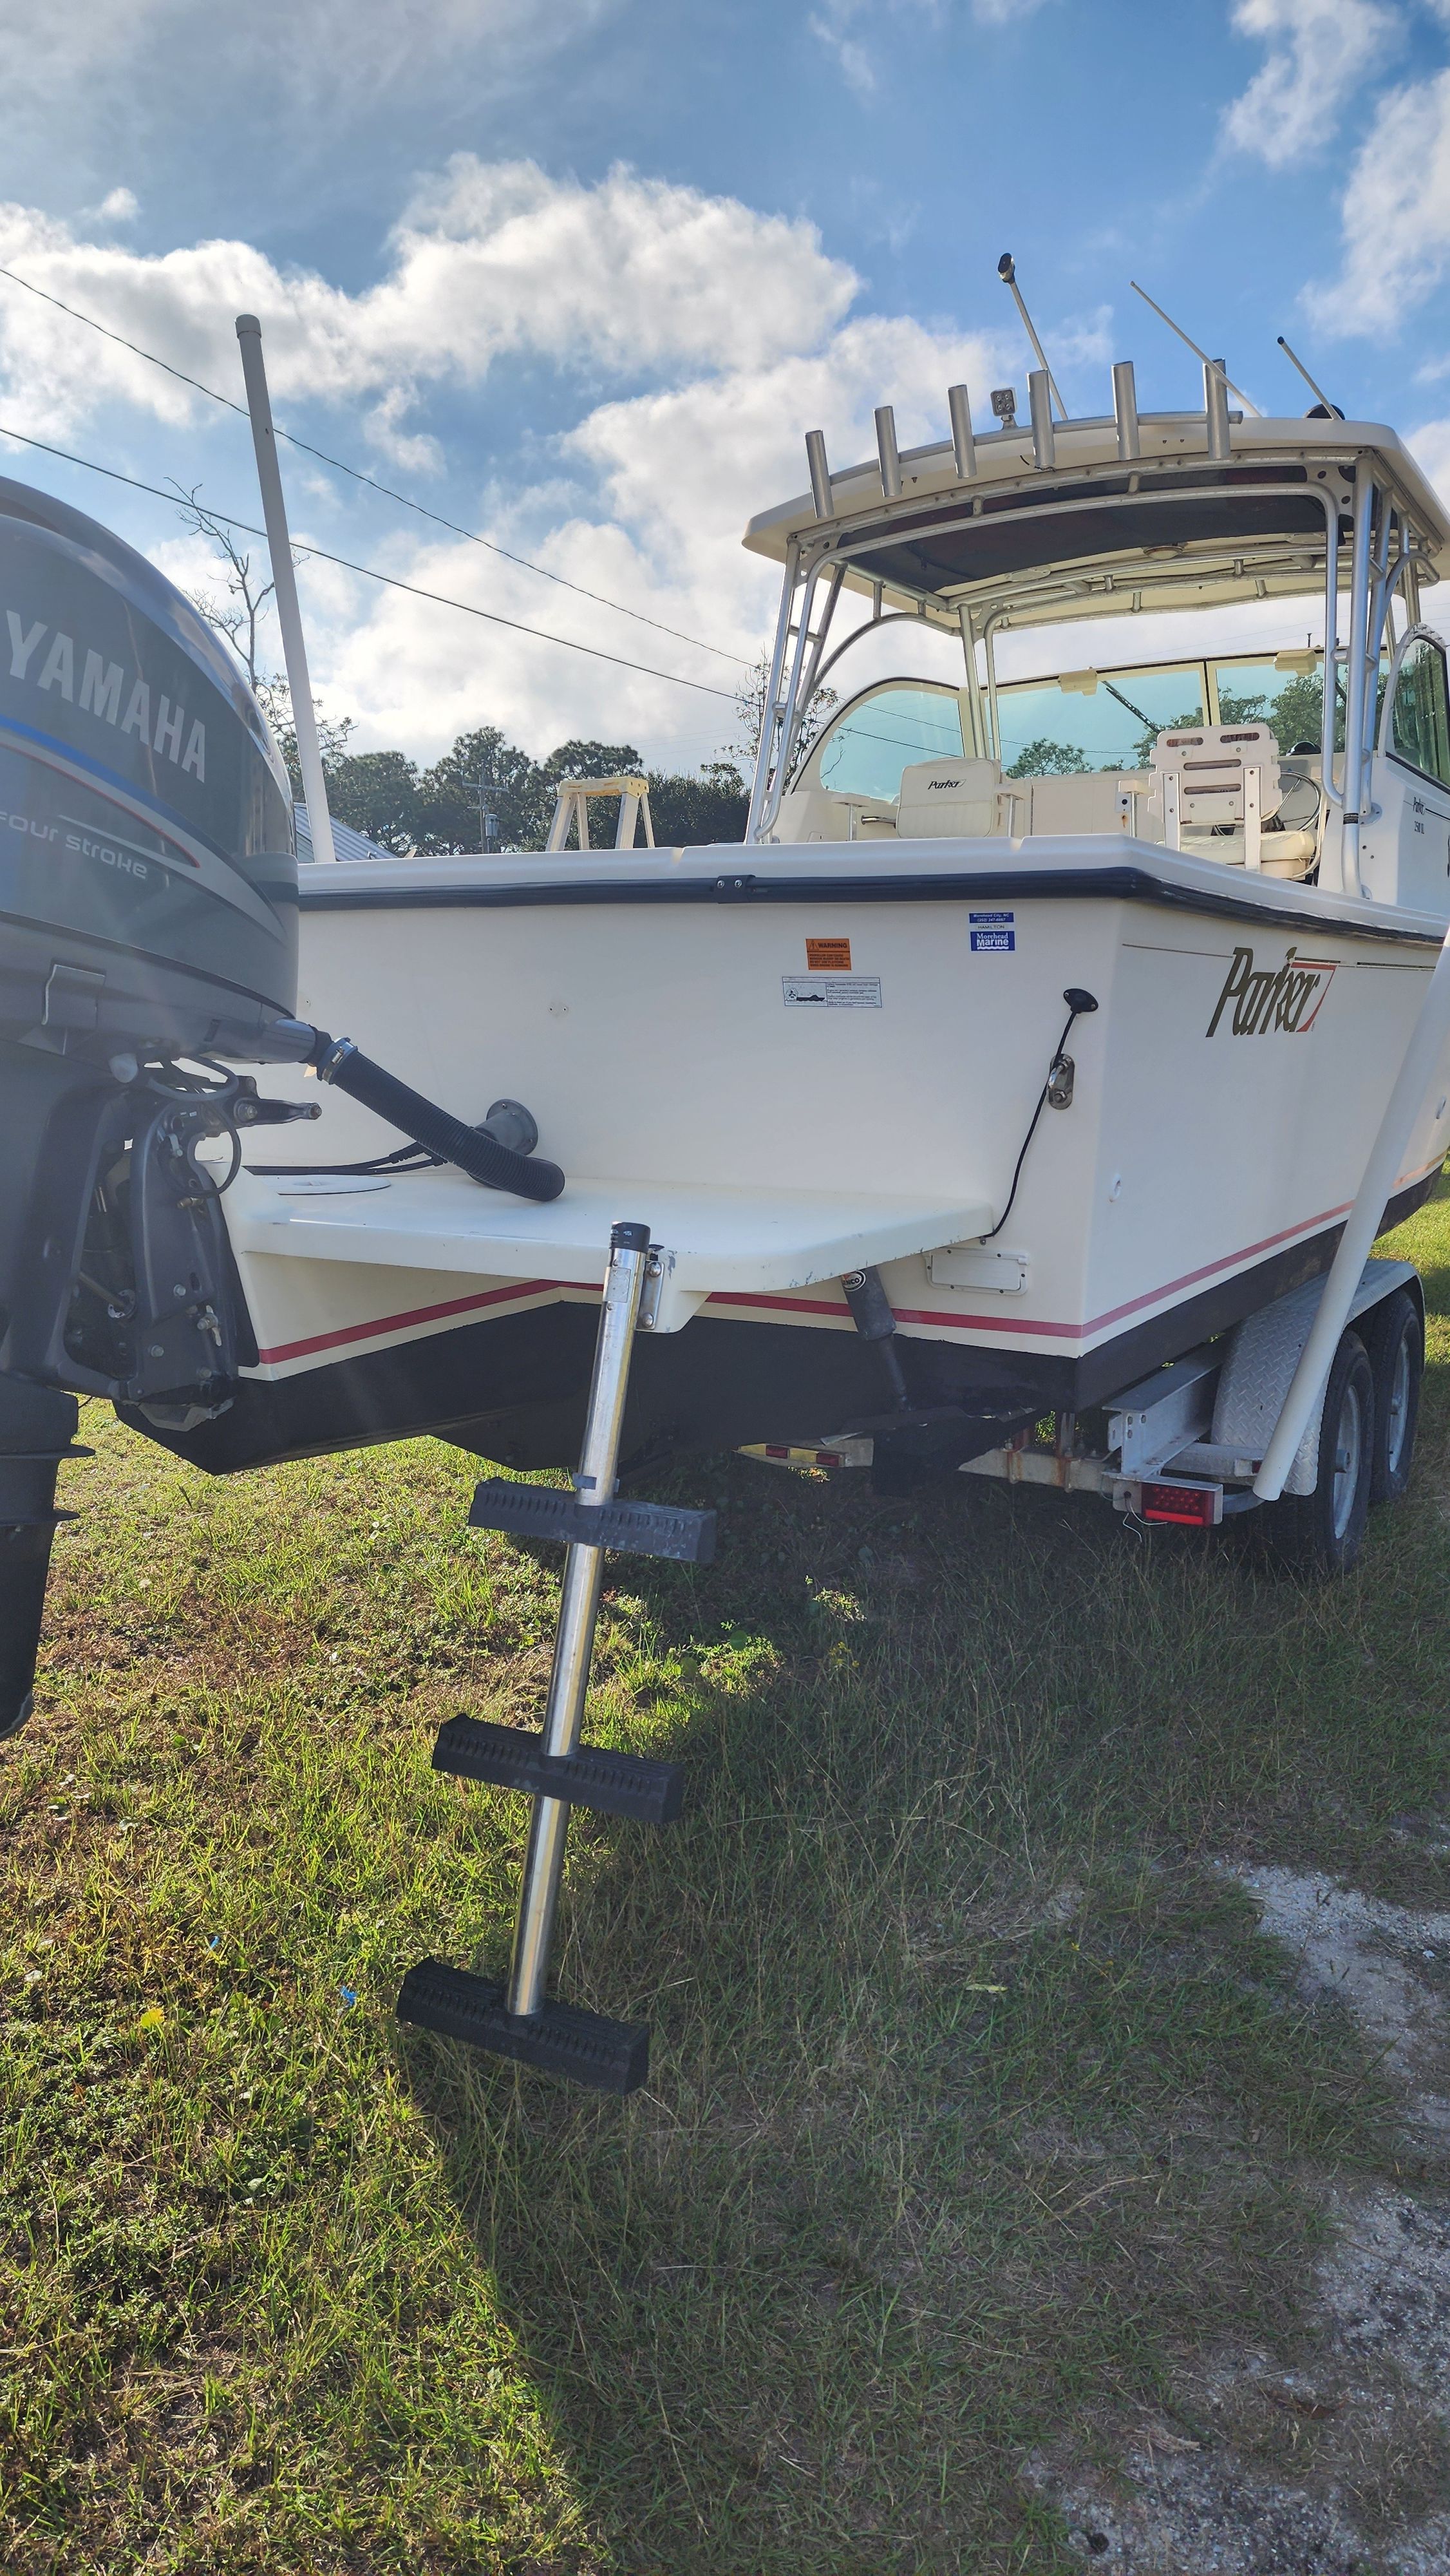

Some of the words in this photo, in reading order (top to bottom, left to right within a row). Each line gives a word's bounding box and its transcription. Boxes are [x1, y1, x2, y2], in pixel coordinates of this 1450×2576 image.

[6, 610, 205, 783] YAMAHA
[927, 779, 961, 790] Parker
[1205, 947, 1321, 1037] Parker
